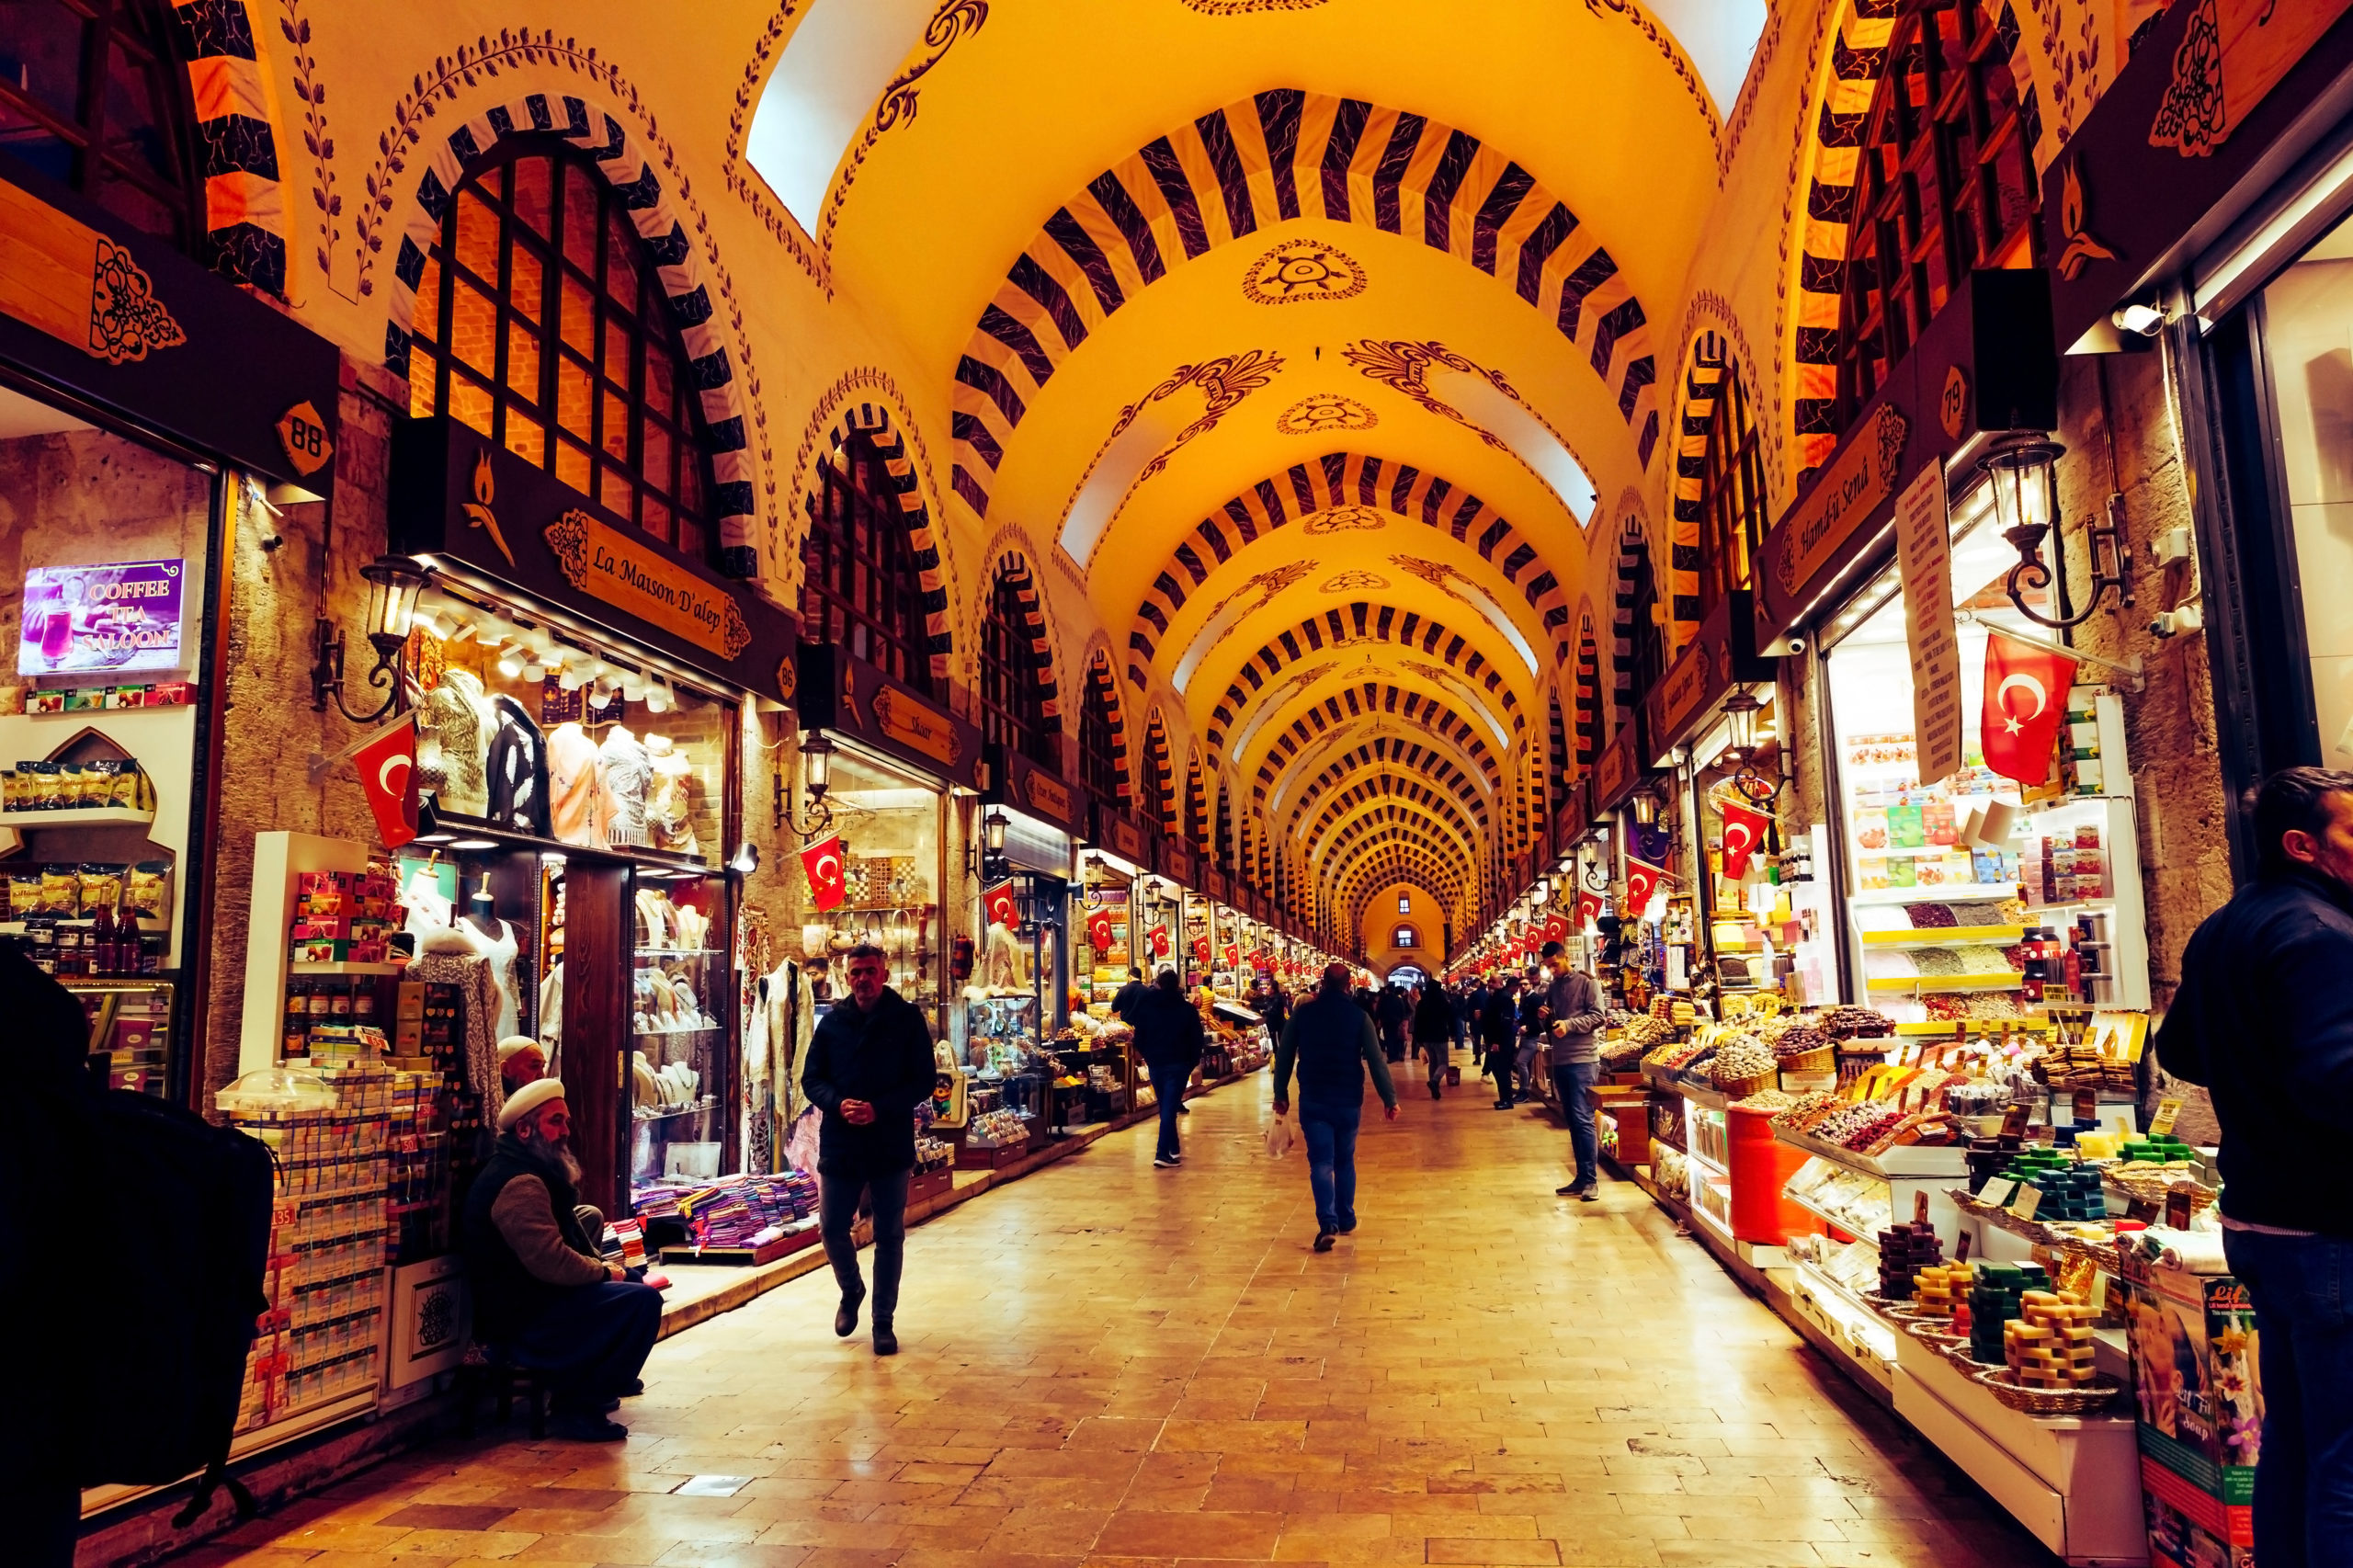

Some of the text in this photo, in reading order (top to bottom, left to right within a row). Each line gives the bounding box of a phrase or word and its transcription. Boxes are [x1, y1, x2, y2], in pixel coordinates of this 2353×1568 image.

[1944, 380, 1961, 424] 79
[291, 416, 322, 458] 88
[1842, 456, 1870, 513] Senâ
[89, 580, 170, 601] COFFEE
[593, 546, 615, 575] La
[678, 590, 722, 634] D'alep
[109, 606, 148, 624] TEA
[83, 630, 171, 652] SALOON
[781, 665, 793, 688] 86
[403, 1140, 414, 1150] 50
[2209, 1285, 2243, 1303] Lif
[2183, 1414, 2209, 1441] Soap
